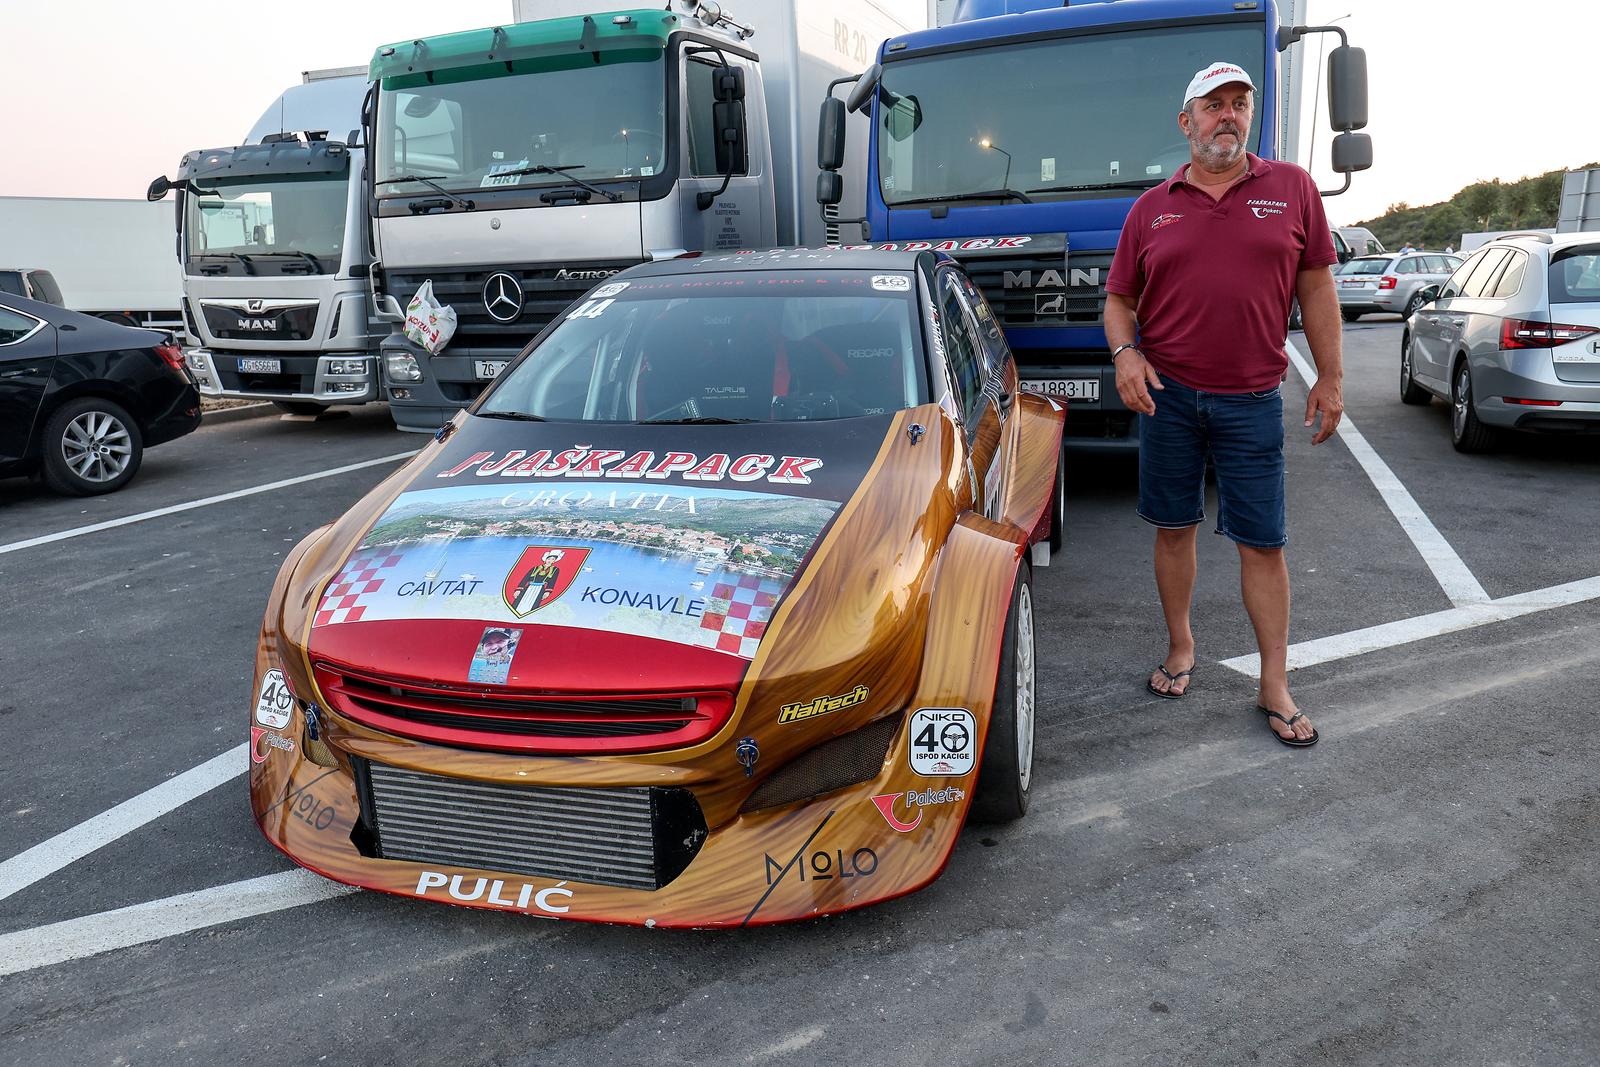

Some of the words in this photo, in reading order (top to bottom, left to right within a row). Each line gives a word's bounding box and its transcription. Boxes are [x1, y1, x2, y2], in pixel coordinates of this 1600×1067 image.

[834, 17, 849, 56] RR
[852, 30, 867, 65] 20
[1003, 267, 1100, 288] MAN
[565, 298, 617, 320] 44
[238, 319, 277, 331] MAN
[482, 363, 495, 376] ZG
[501, 490, 700, 514] CROATIA
[397, 580, 483, 597] CAVTAT
[581, 586, 705, 618] KONAVLE
[780, 686, 868, 723] Haltech
[920, 713, 966, 722] NIKO
[914, 722, 970, 753] 40
[415, 871, 574, 913] PULIĆ
